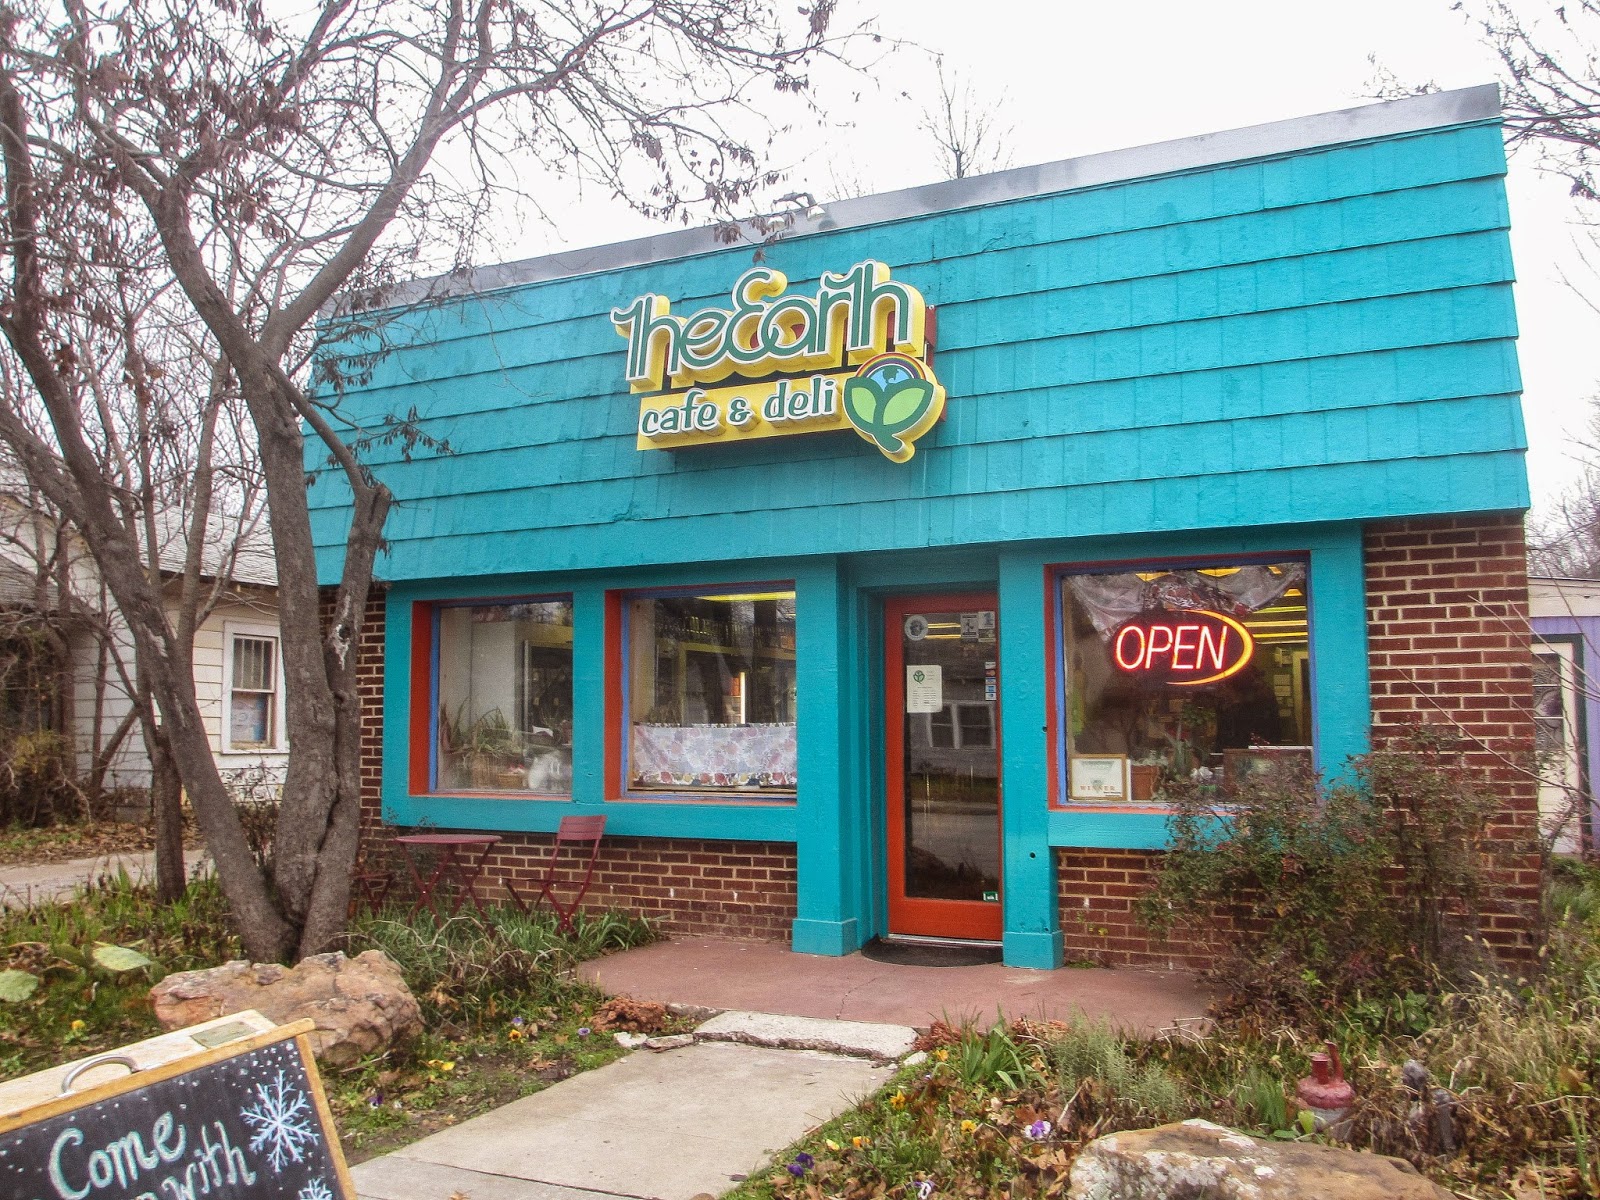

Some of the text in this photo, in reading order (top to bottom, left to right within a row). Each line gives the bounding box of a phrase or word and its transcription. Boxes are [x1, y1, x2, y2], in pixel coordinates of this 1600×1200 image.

[640, 374, 838, 436] cafe & deli
[1115, 624, 1229, 671] OPEN
[49, 1111, 187, 1200] Come
